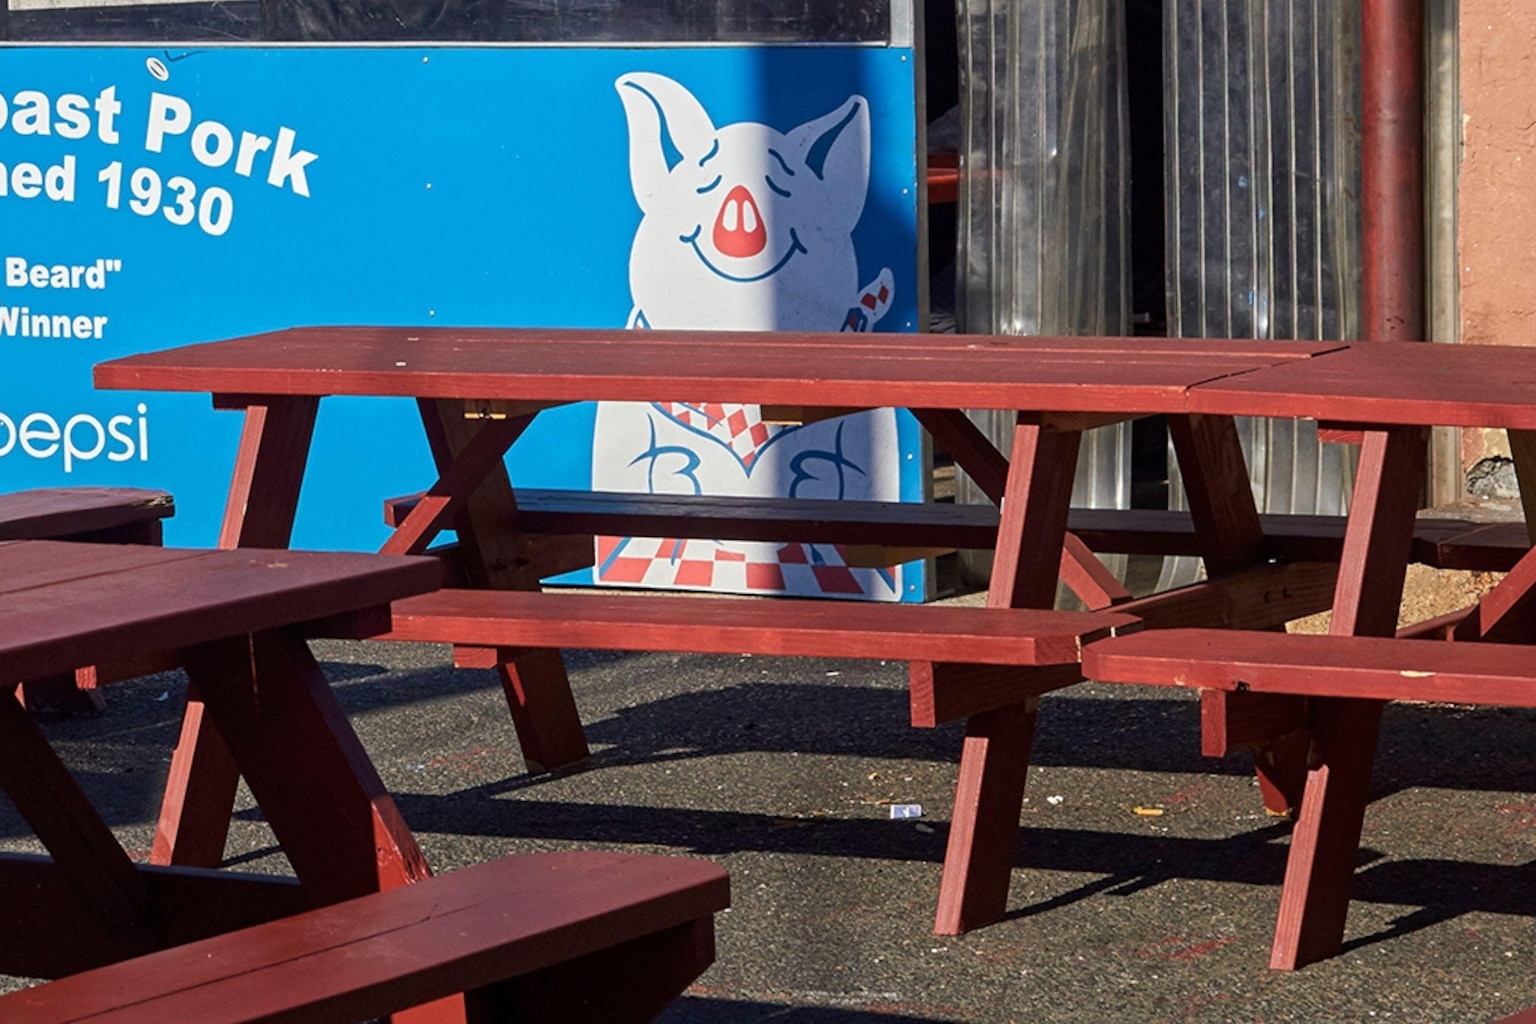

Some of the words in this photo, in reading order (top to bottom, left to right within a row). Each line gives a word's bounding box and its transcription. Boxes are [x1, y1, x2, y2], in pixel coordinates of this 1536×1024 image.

[145, 91, 319, 198] Pork
[98, 161, 234, 236] 1930
[5, 257, 122, 289] Beard"
